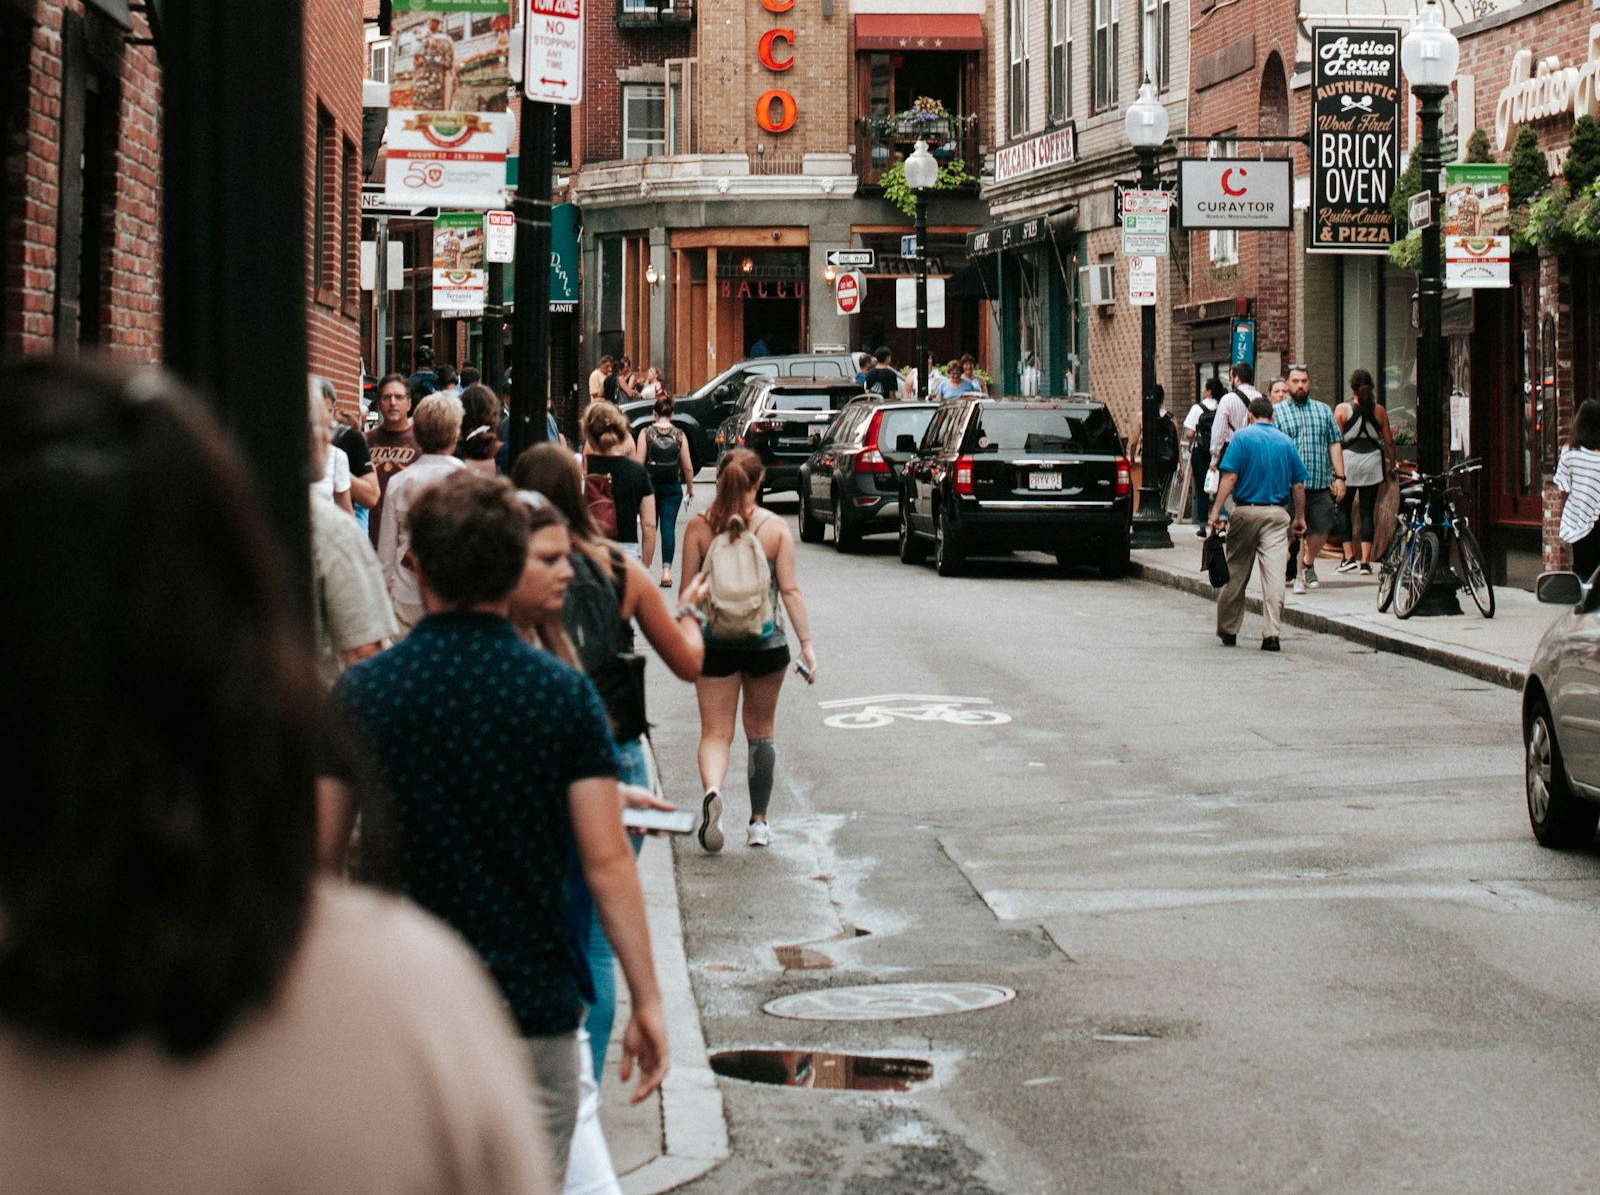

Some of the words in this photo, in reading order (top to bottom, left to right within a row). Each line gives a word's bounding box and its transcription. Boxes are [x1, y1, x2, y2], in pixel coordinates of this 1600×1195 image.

[546, 20, 565, 35] NO
[534, 35, 576, 49] STOPPING
[1320, 36, 1395, 60] Antico
[546, 50, 563, 59] ANY
[546, 60, 562, 70] TIME
[1323, 53, 1391, 76] Forno
[1316, 80, 1397, 101] AUTHENTIC
[1318, 114, 1357, 131] Wood
[1357, 113, 1394, 132] Fired
[998, 139, 1036, 179] POLCARI'S
[1039, 129, 1071, 165] COFFEE
[1322, 133, 1393, 168] BRICK
[1326, 168, 1386, 203] OVEN
[362, 195, 379, 206] NE
[1197, 201, 1274, 212] CURAYTOR
[490, 215, 500, 224] TOW
[501, 215, 512, 225] ZONE
[1319, 207, 1353, 226] Rustic
[1351, 207, 1393, 225] Cuisine
[1320, 226, 1333, 242] &
[1338, 227, 1391, 242] PIZZA
[550, 252, 571, 297] Dente
[721, 279, 804, 298] BACCO
